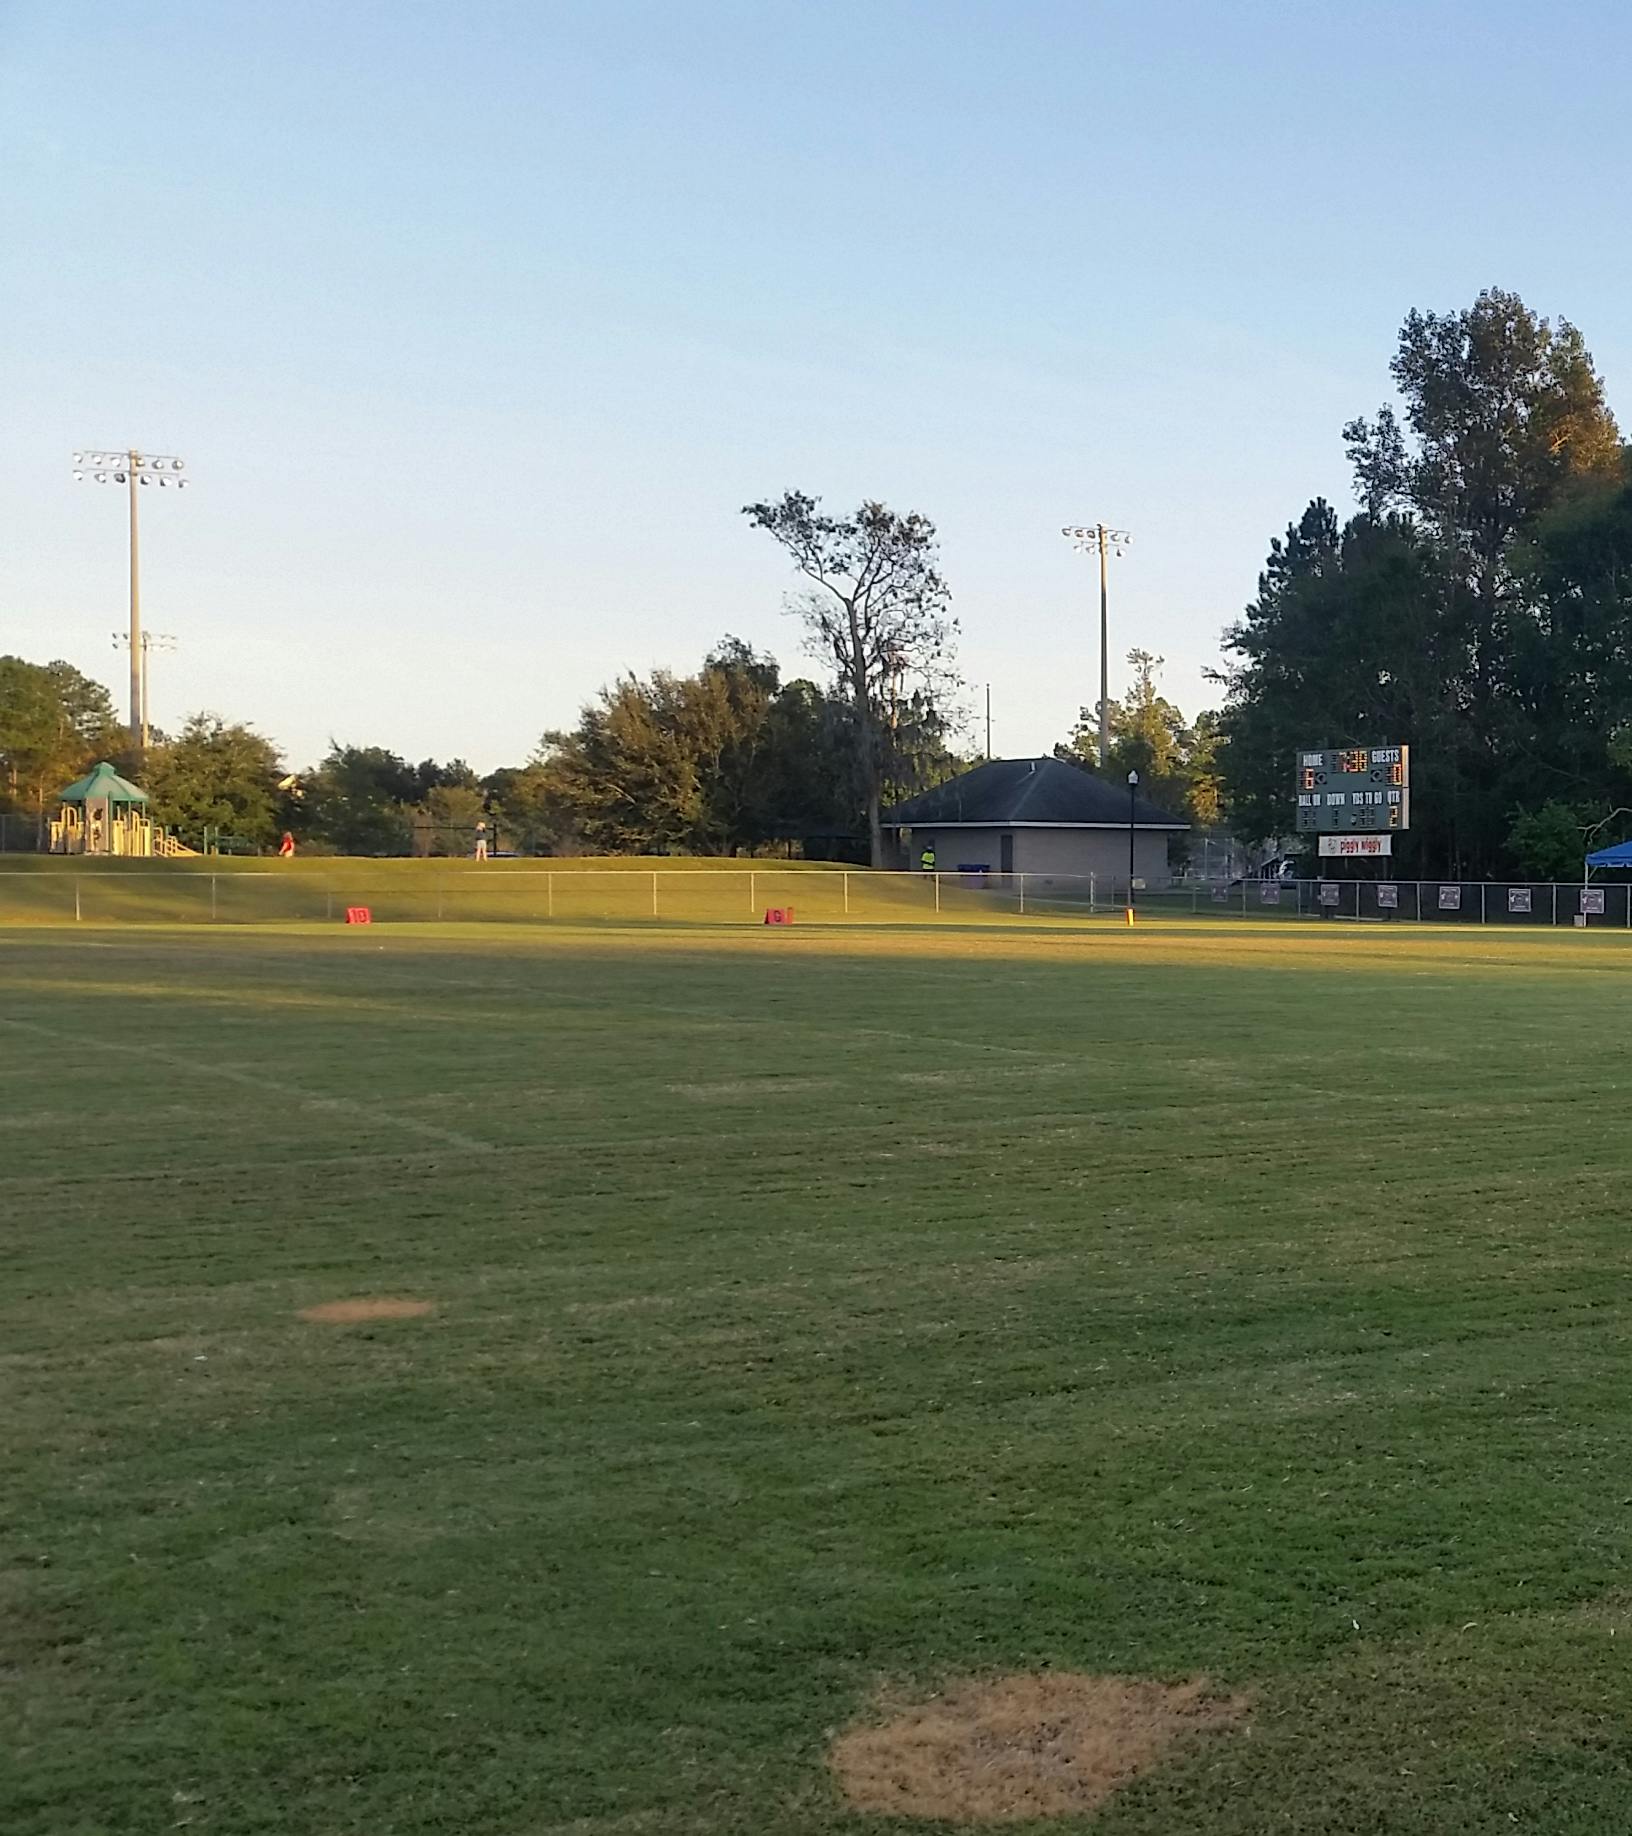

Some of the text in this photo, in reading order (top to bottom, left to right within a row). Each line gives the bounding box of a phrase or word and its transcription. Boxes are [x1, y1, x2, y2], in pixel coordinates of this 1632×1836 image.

[1303, 754, 1323, 767] HOME
[1371, 749, 1399, 763] GUESTS
[1326, 793, 1345, 805] DOWN
[1387, 790, 1400, 804] QTR
